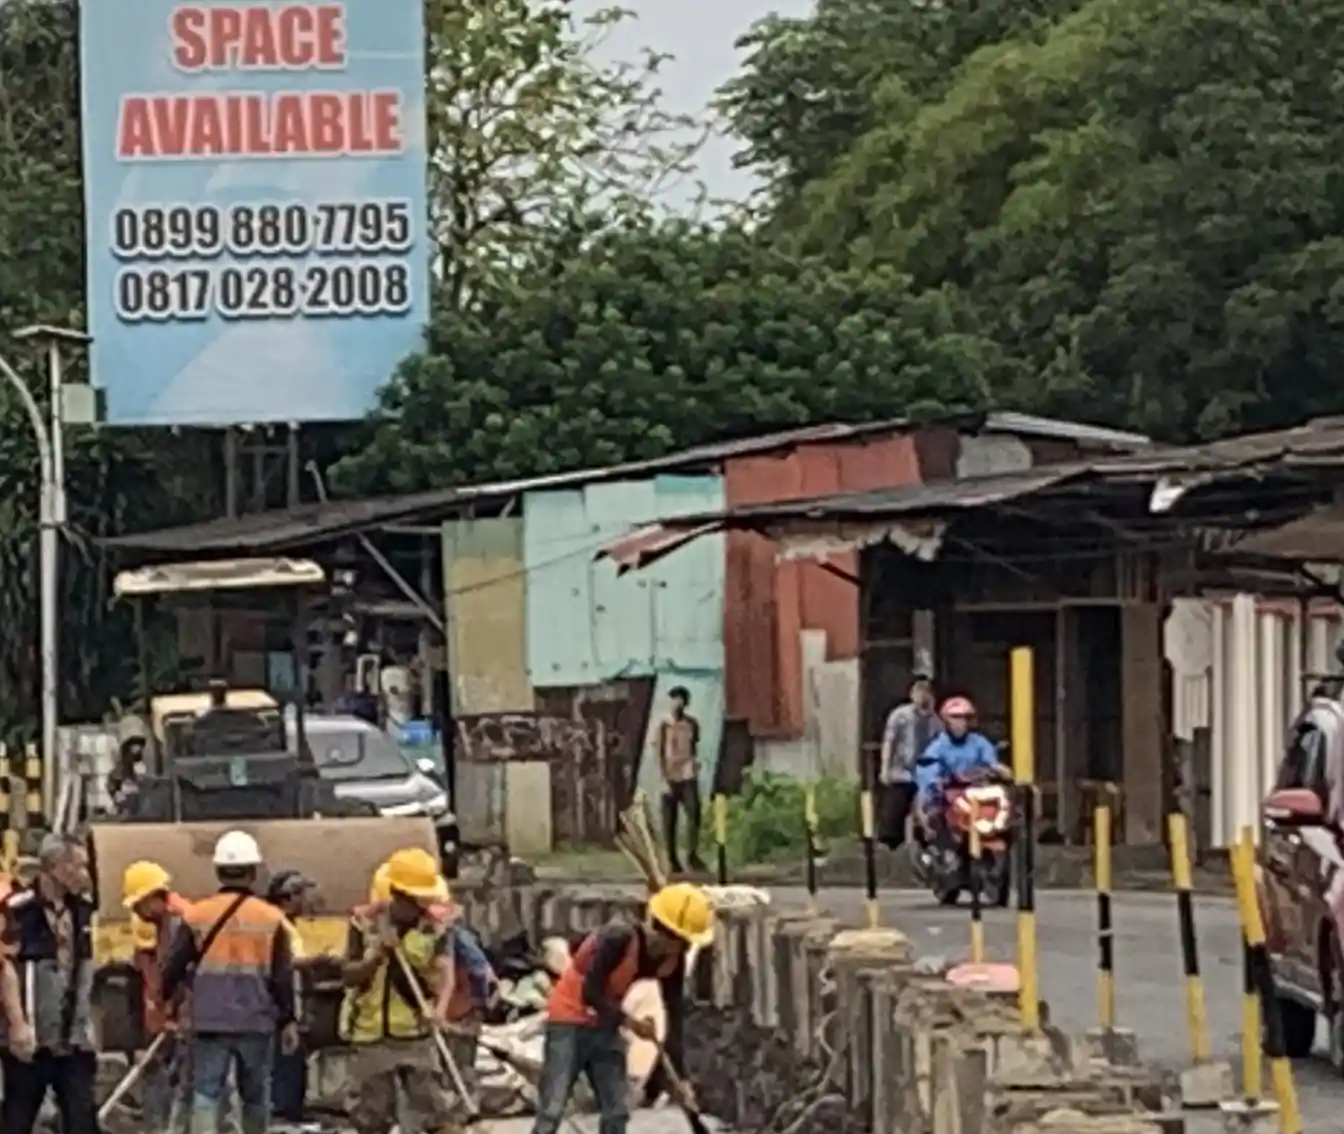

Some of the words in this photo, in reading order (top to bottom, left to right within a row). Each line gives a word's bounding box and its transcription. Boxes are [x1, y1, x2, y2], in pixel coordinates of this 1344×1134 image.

[174, 6, 344, 68] SPACE
[119, 92, 401, 156] AVAILABLE
[115, 208, 219, 250] 0899
[231, 205, 307, 247] 880
[317, 202, 409, 245] 7795
[121, 269, 210, 313] 0817
[221, 266, 295, 310] 028
[307, 264, 408, 308] 2008
